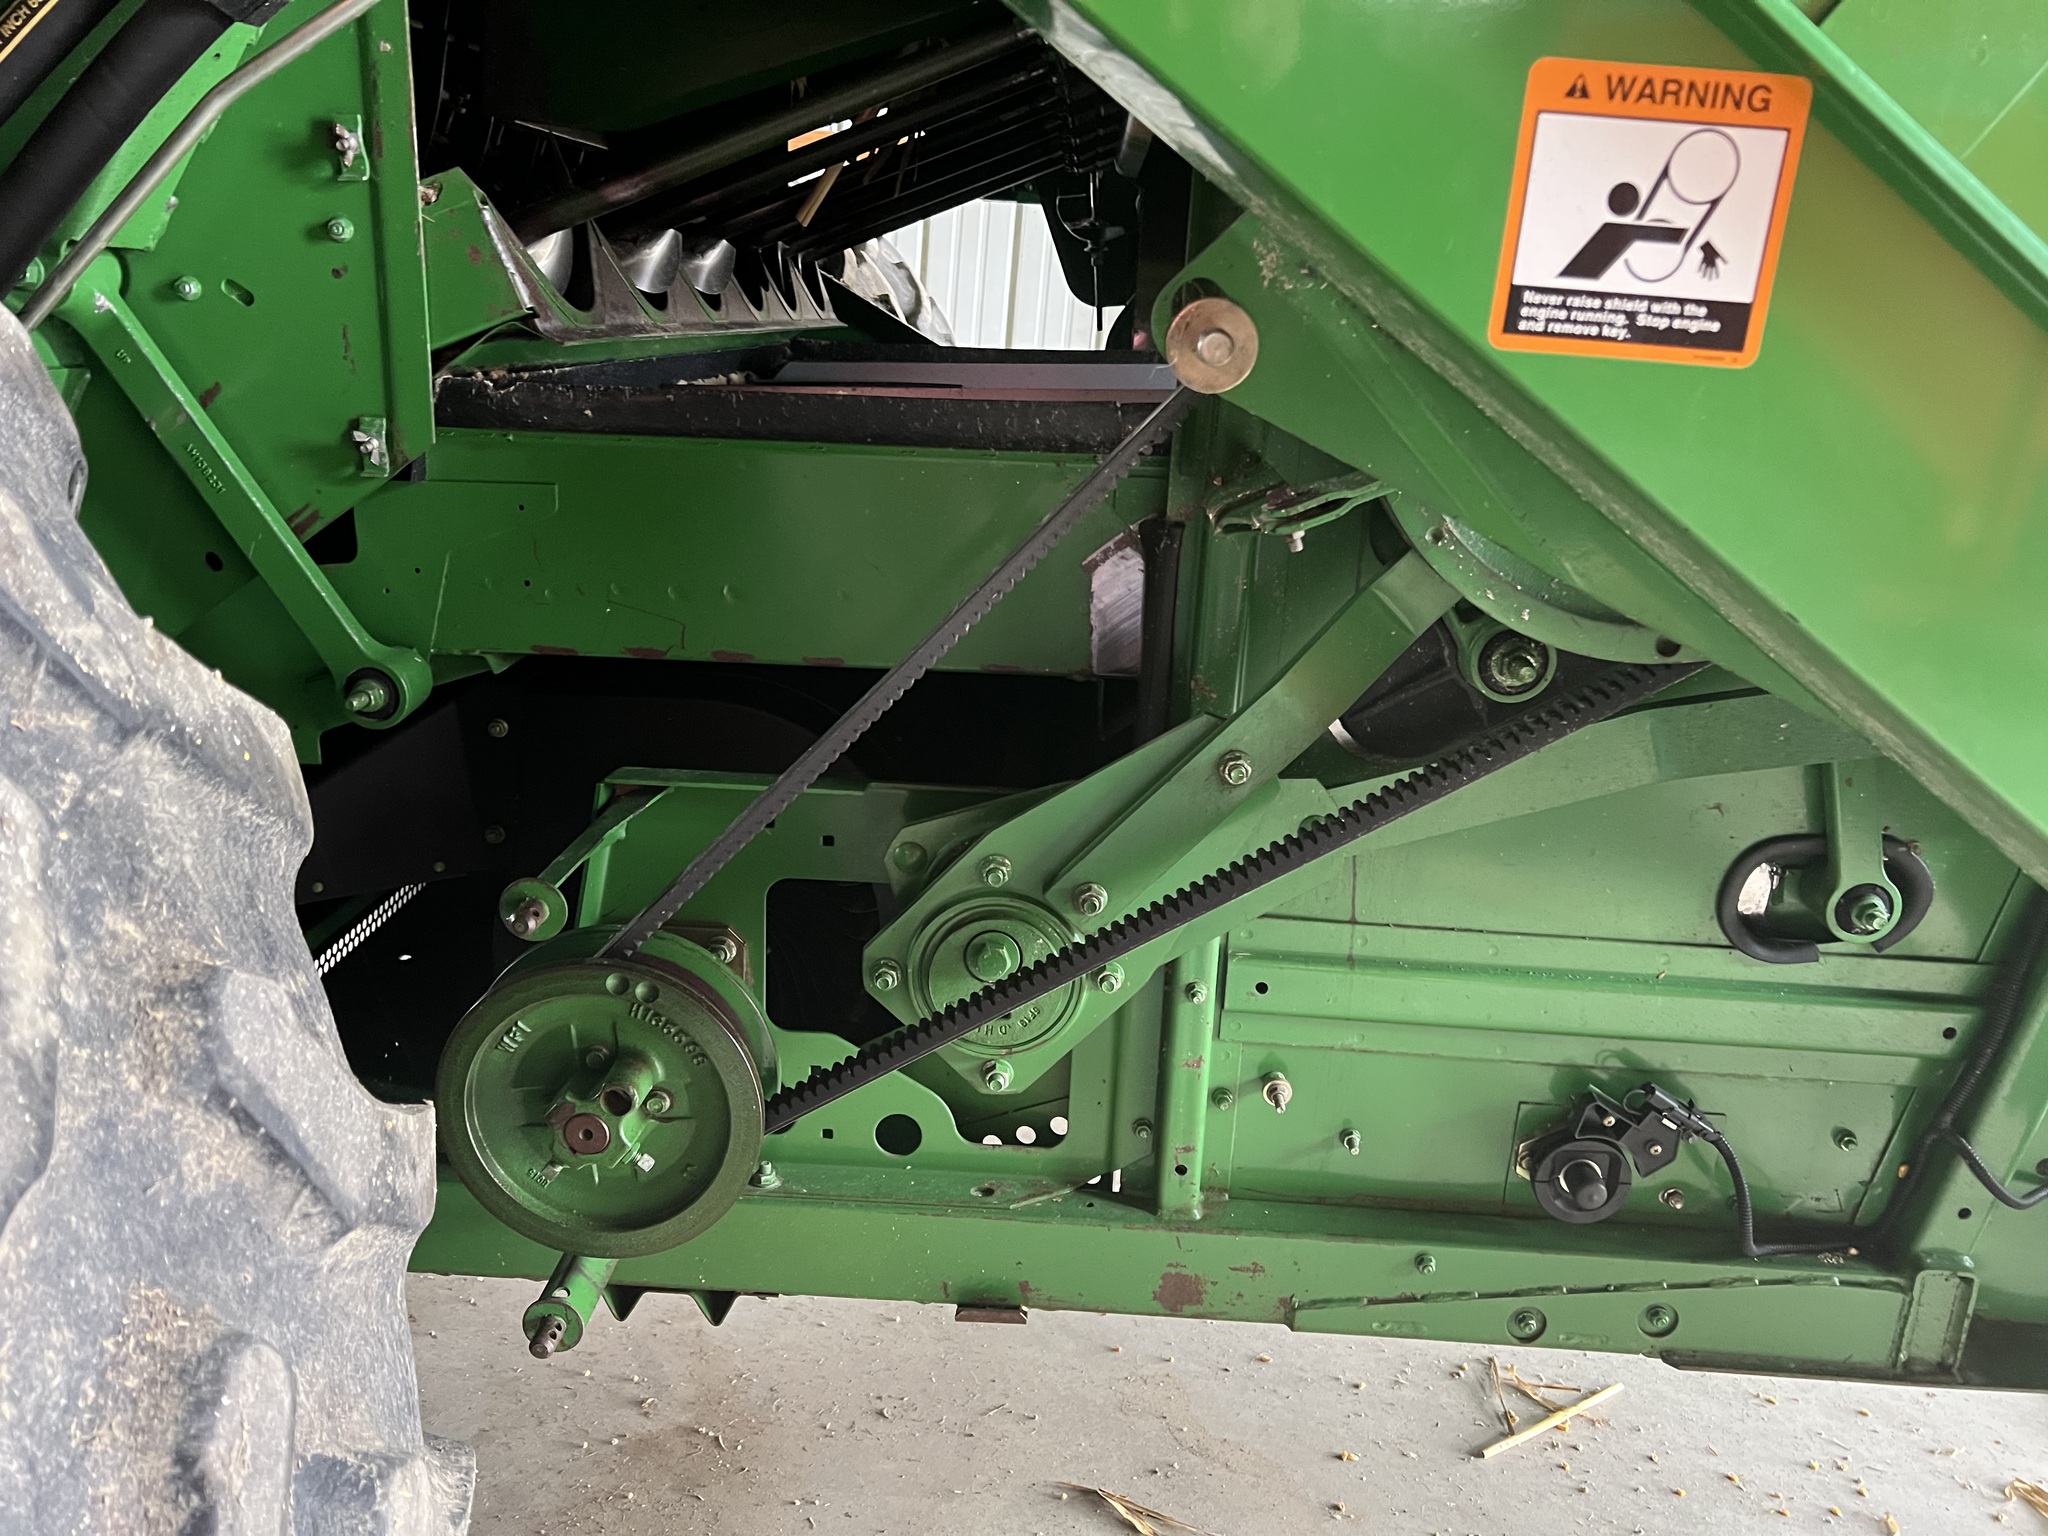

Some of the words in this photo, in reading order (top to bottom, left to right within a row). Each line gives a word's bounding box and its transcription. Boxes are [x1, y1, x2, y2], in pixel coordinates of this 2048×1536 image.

[0, 4, 31, 38] INCH
[1606, 73, 1773, 113] WARNING
[1523, 290, 1565, 306] Never
[1566, 294, 1602, 309] raise
[1604, 297, 1649, 312] shield
[1651, 300, 1682, 315] with
[1683, 302, 1709, 318] the
[1518, 319, 1546, 332] and
[1547, 323, 1600, 336] remove
[1601, 324, 1632, 340] key.
[1520, 306, 1568, 321] engine
[1570, 310, 1629, 327] running.
[1635, 313, 1671, 330] Stop
[1672, 317, 1722, 334] engine
